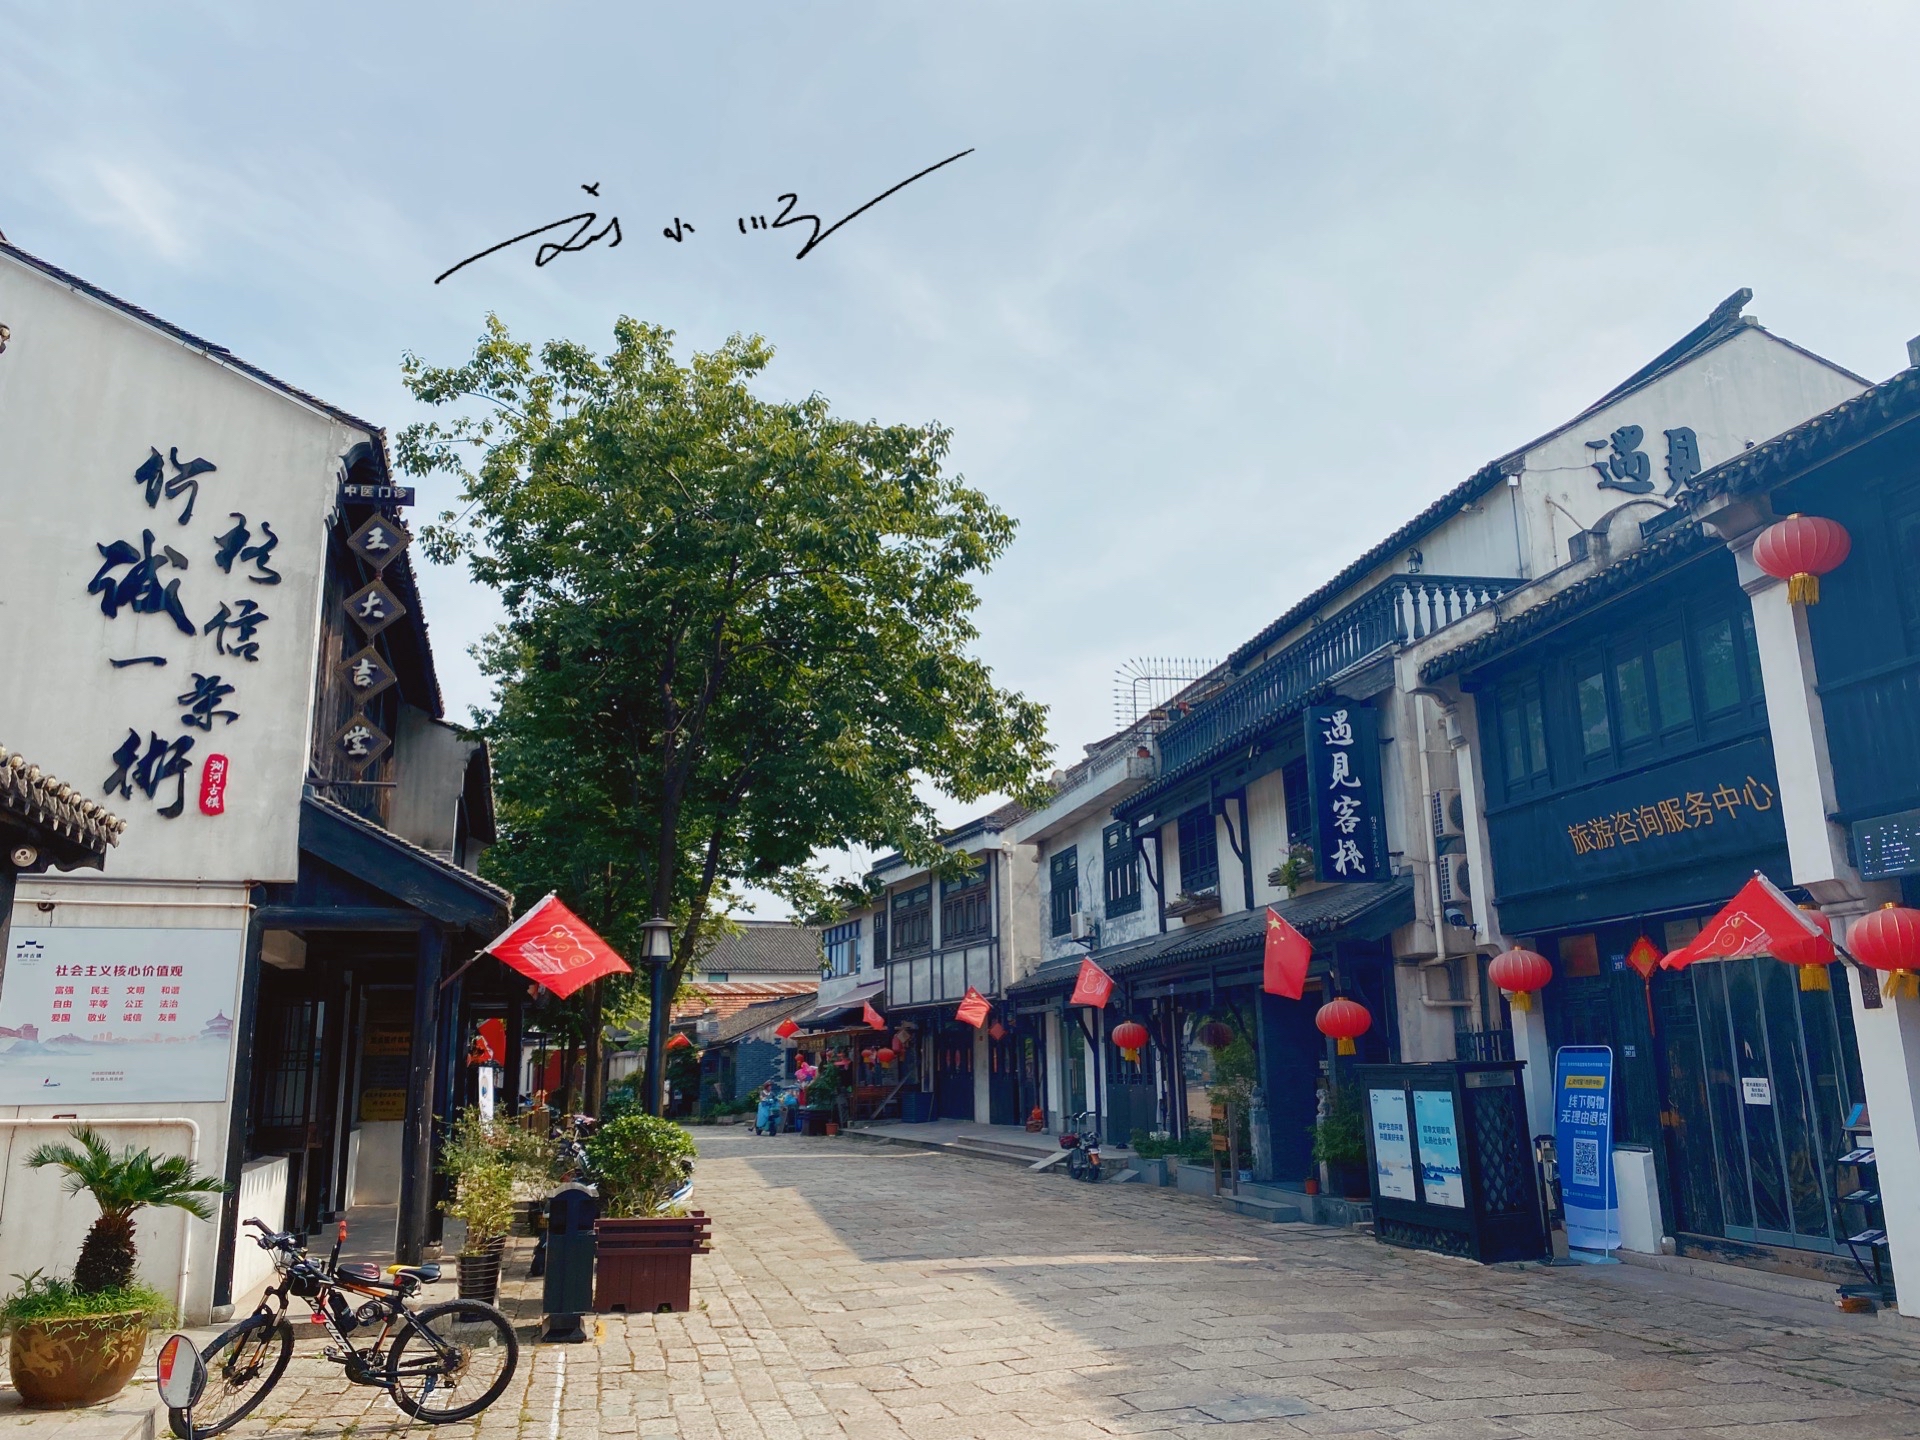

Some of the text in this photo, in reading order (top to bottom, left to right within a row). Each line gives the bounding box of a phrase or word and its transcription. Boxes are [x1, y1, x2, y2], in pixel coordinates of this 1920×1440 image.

[344, 484, 407, 499] 中医门诊
[343, 526, 390, 757] 王大吉堂
[1567, 775, 1774, 856] 旅游咨询服务中心
[55, 965, 184, 977] 社会主义核心价值观
[54, 986, 180, 995] 富强 民主 文明 和谐
[53, 1000, 179, 1009] 自由 平等 公正 法治
[51, 1013, 177, 1022] 爱国 敬业 诚信 友善
[1568, 1094, 1605, 1110] 线下购物
[1560, 1109, 1608, 1126] 无理由退货
